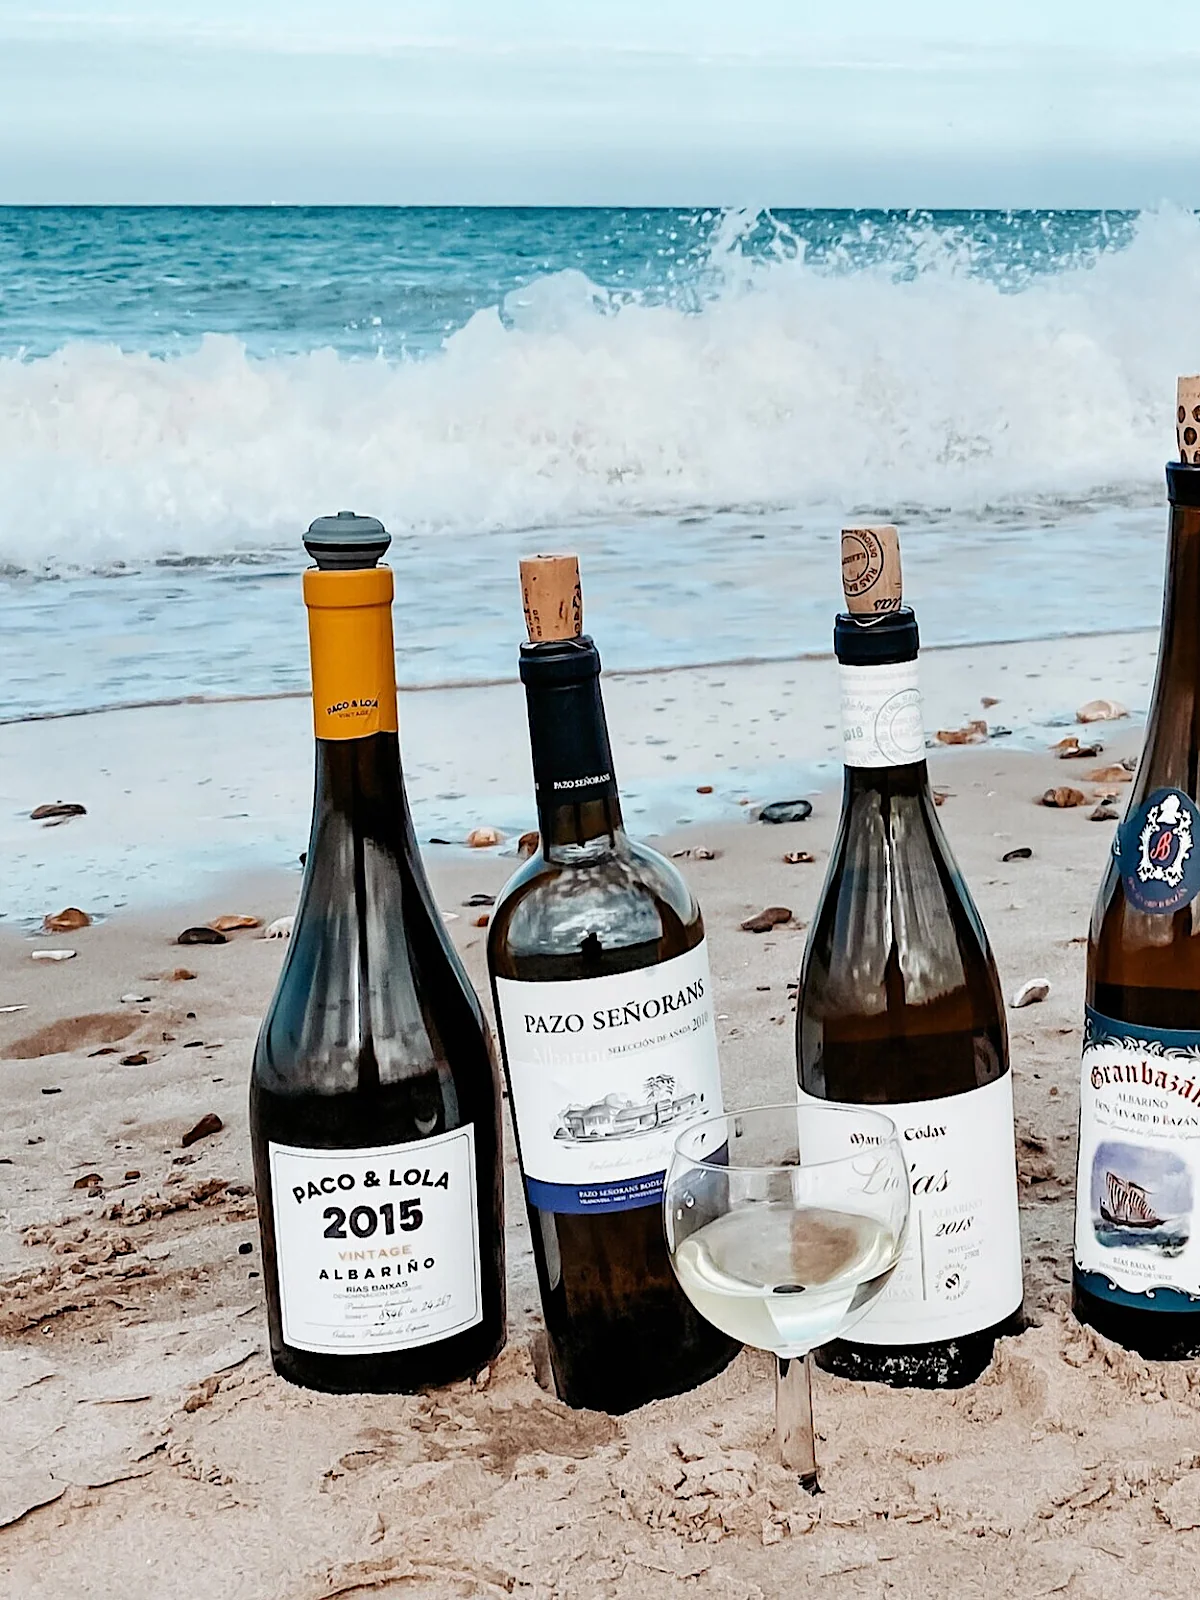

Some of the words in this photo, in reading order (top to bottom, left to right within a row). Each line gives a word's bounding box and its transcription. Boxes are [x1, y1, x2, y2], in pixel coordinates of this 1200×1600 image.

[327, 701, 350, 715] PACO
[351, 700, 358, 708] &
[553, 780, 575, 790] PAZO
[524, 1014, 584, 1034] PAZO
[592, 978, 705, 1031] SEÑORANS
[607, 1037, 656, 1055] SELECCIÓN
[292, 1173, 356, 1204] PACO
[363, 1171, 381, 1188] &
[389, 1168, 449, 1190] LOLA
[579, 1191, 599, 1199] PAZO
[322, 1197, 424, 1239] 2015
[935, 1216, 975, 1238] 2018
[338, 1244, 413, 1262] VINTAGE
[319, 1257, 436, 1281] ALBARIÑO
[371, 1280, 409, 1292] BAIXAS
